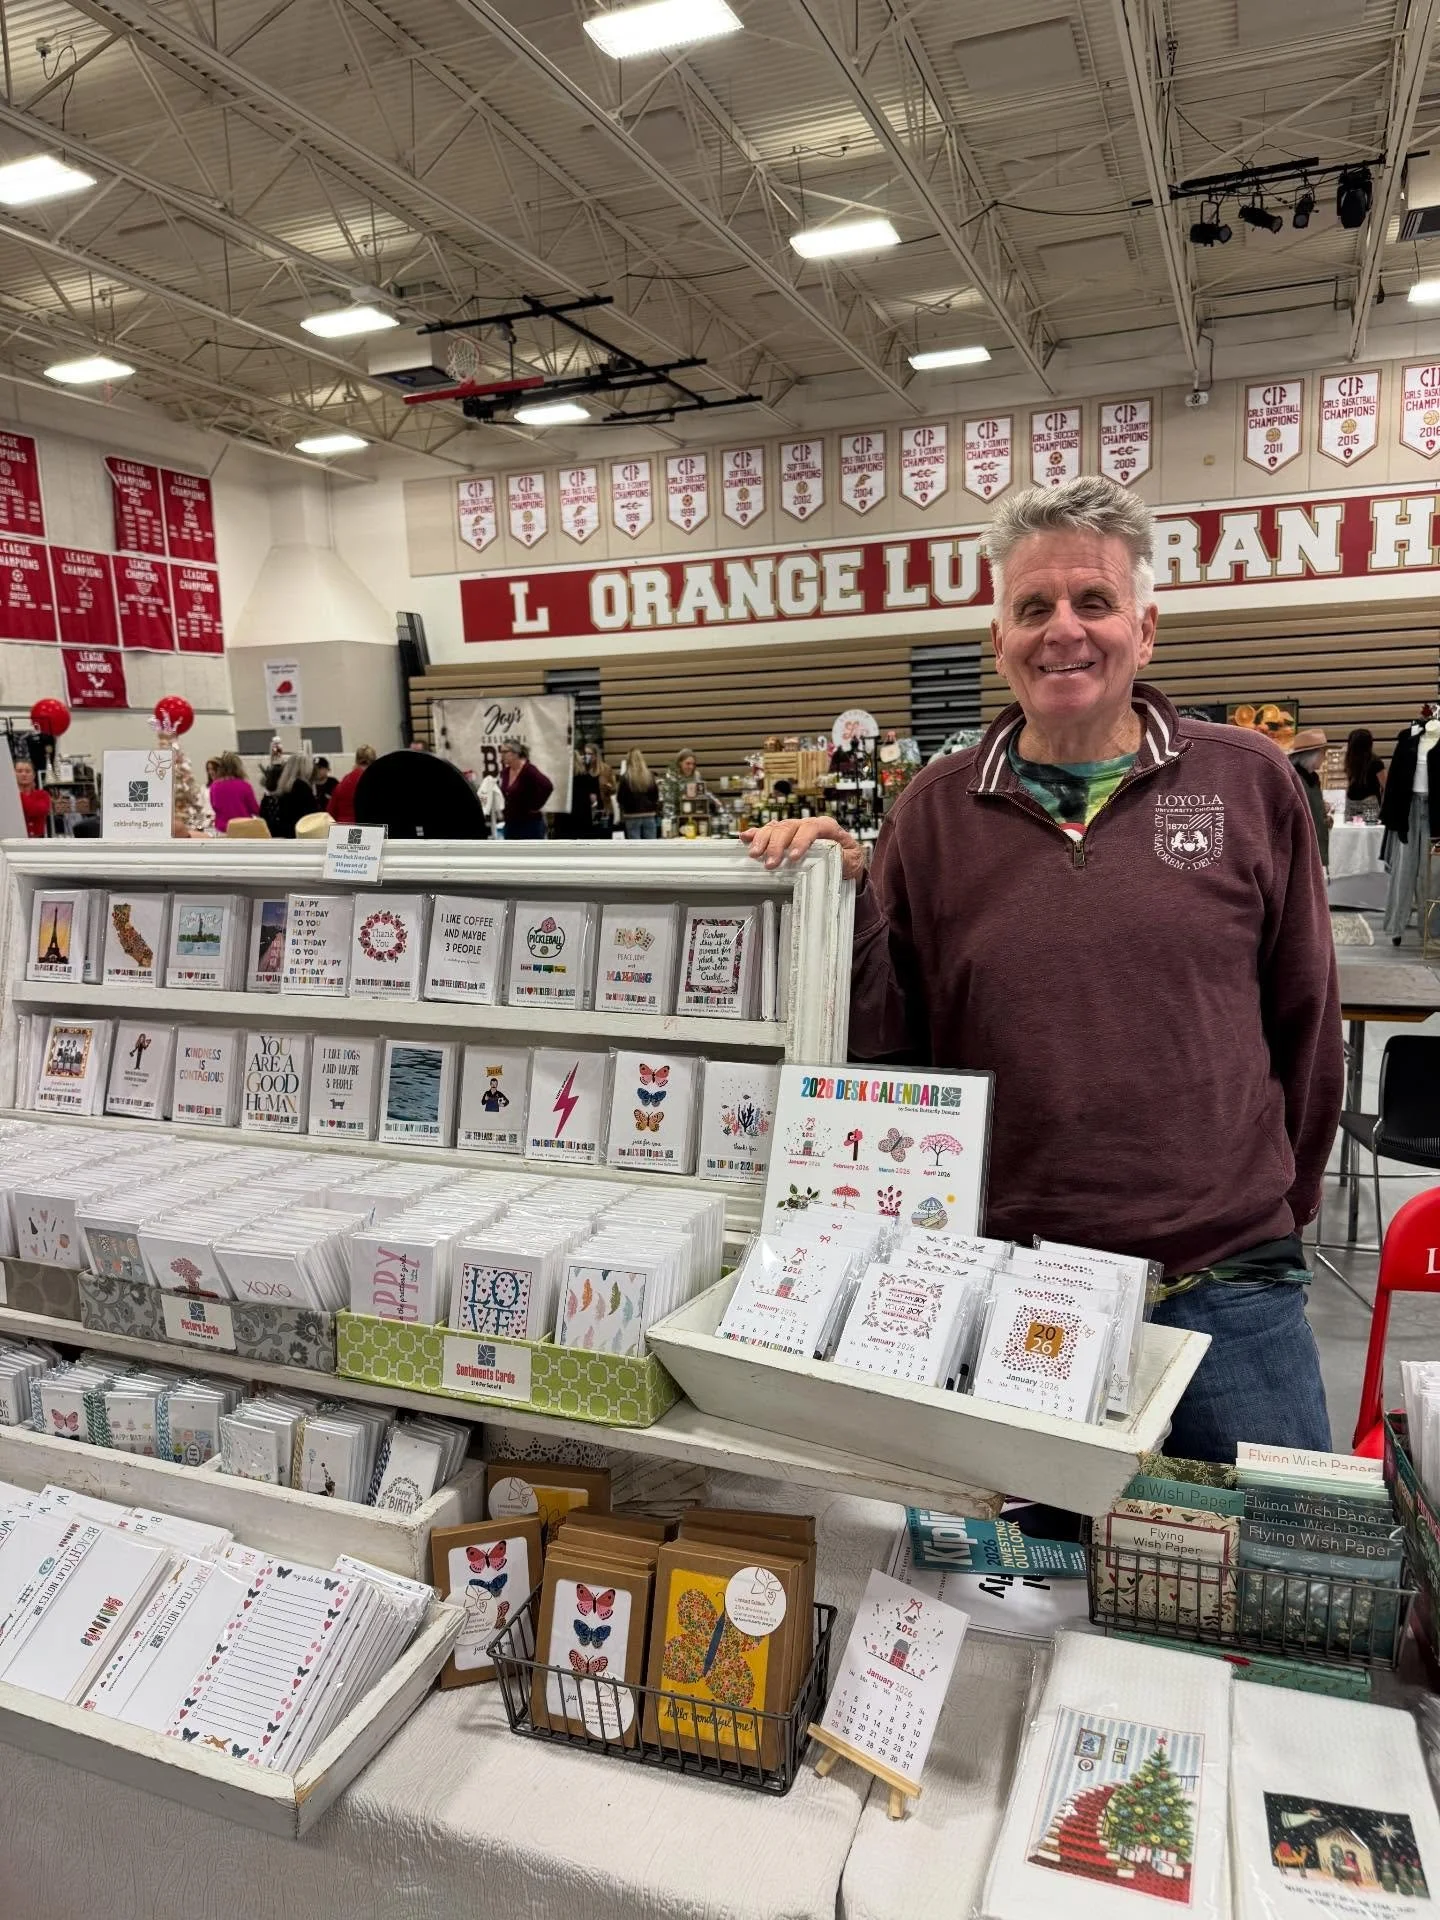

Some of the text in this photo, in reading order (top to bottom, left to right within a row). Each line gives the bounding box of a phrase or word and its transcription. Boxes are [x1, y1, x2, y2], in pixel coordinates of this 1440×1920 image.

[1338, 377, 1364, 396] CIF
[1262, 386, 1287, 405] CIF
[1323, 396, 1376, 408] GIRLS BASKETBALL
[1114, 405, 1137, 423] CIF
[1266, 405, 1300, 417] BASKETBALL
[1324, 406, 1375, 420] CHAMPIONS
[1045, 412, 1067, 431] CIF
[1249, 416, 1299, 429] CHAMPIONS
[914, 429, 934, 447] CIF
[977, 421, 999, 439] CIF
[1053, 430, 1079, 440] SOCCER
[852, 437, 873, 454] CIF
[1033, 440, 1078, 452] CHAMPIONS
[1102, 432, 1149, 445] CHAMPIONS
[1338, 434, 1360, 446] 2015
[792, 445, 811, 461] CIF
[967, 448, 1009, 460] CHAMPIONS
[1264, 444, 1283, 454] 2011
[733, 452, 752, 469] CIF
[842, 463, 883, 474] CHAMPIONS
[903, 455, 945, 467] CHAMPIONS
[1114, 458, 1136, 469] 2009
[978, 474, 998, 483] 2005
[1045, 466, 1066, 477] 2006
[509, 581, 550, 634] L
[590, 549, 864, 631] ORANGE
[1155, 794, 1223, 807] LOYOLA
[1213, 812, 1224, 858] GLORIAM
[446, 914, 461, 924] LIKE
[464, 916, 493, 928] COFFEE
[371, 928, 395, 938] Thank
[444, 929, 487, 941] AND MAYBE
[530, 934, 562, 945] PICKLEBALL
[376, 940, 389, 948] You
[446, 943, 482, 955] 3 PEOPLE
[606, 971, 652, 984] MAHJONG
[185, 1047, 222, 1060] KINDNESS
[260, 1035, 292, 1056] YOU
[200, 1060, 206, 1069] IS
[249, 1053, 295, 1073] ARE A
[179, 1070, 225, 1083] CONTAGIOUS
[247, 1072, 300, 1094] GOOD
[333, 1078, 354, 1090] PEOPLE
[801, 1076, 940, 1107] 2026 DESK CALENDAR
[246, 1093, 296, 1113] HUMAN
[895, 1167, 911, 1175] 2026
[923, 1169, 936, 1177] April
[937, 1170, 951, 1178] 2026
[243, 1280, 291, 1297] XOXO
[754, 1301, 779, 1313] January
[1034, 1324, 1057, 1341] 20
[867, 1336, 896, 1347] January
[1031, 1338, 1053, 1354] 26
[456, 1363, 494, 1381] Sentiments
[495, 1369, 516, 1385] Cards
[1006, 1373, 1060, 1392] January 2026
[1149, 1483, 1236, 1510] Wish Paper
[1294, 1502, 1331, 1517] Wish
[1149, 1527, 1185, 1543] Flying
[1249, 1525, 1393, 1558] Flying Wish Paper
[68, 1526, 99, 1564] BEACHY
[994, 1521, 1015, 1568] INVESTING
[1006, 1521, 1030, 1569] OUTLOOK
[1133, 1536, 1202, 1555] Wish Paper
[985, 1539, 1000, 1567] 2026
[39, 1582, 59, 1609] NOTES
[160, 1592, 193, 1637] FLAT NOTES
[896, 1622, 918, 1639] 2026
[867, 1668, 913, 1699] January 2026
